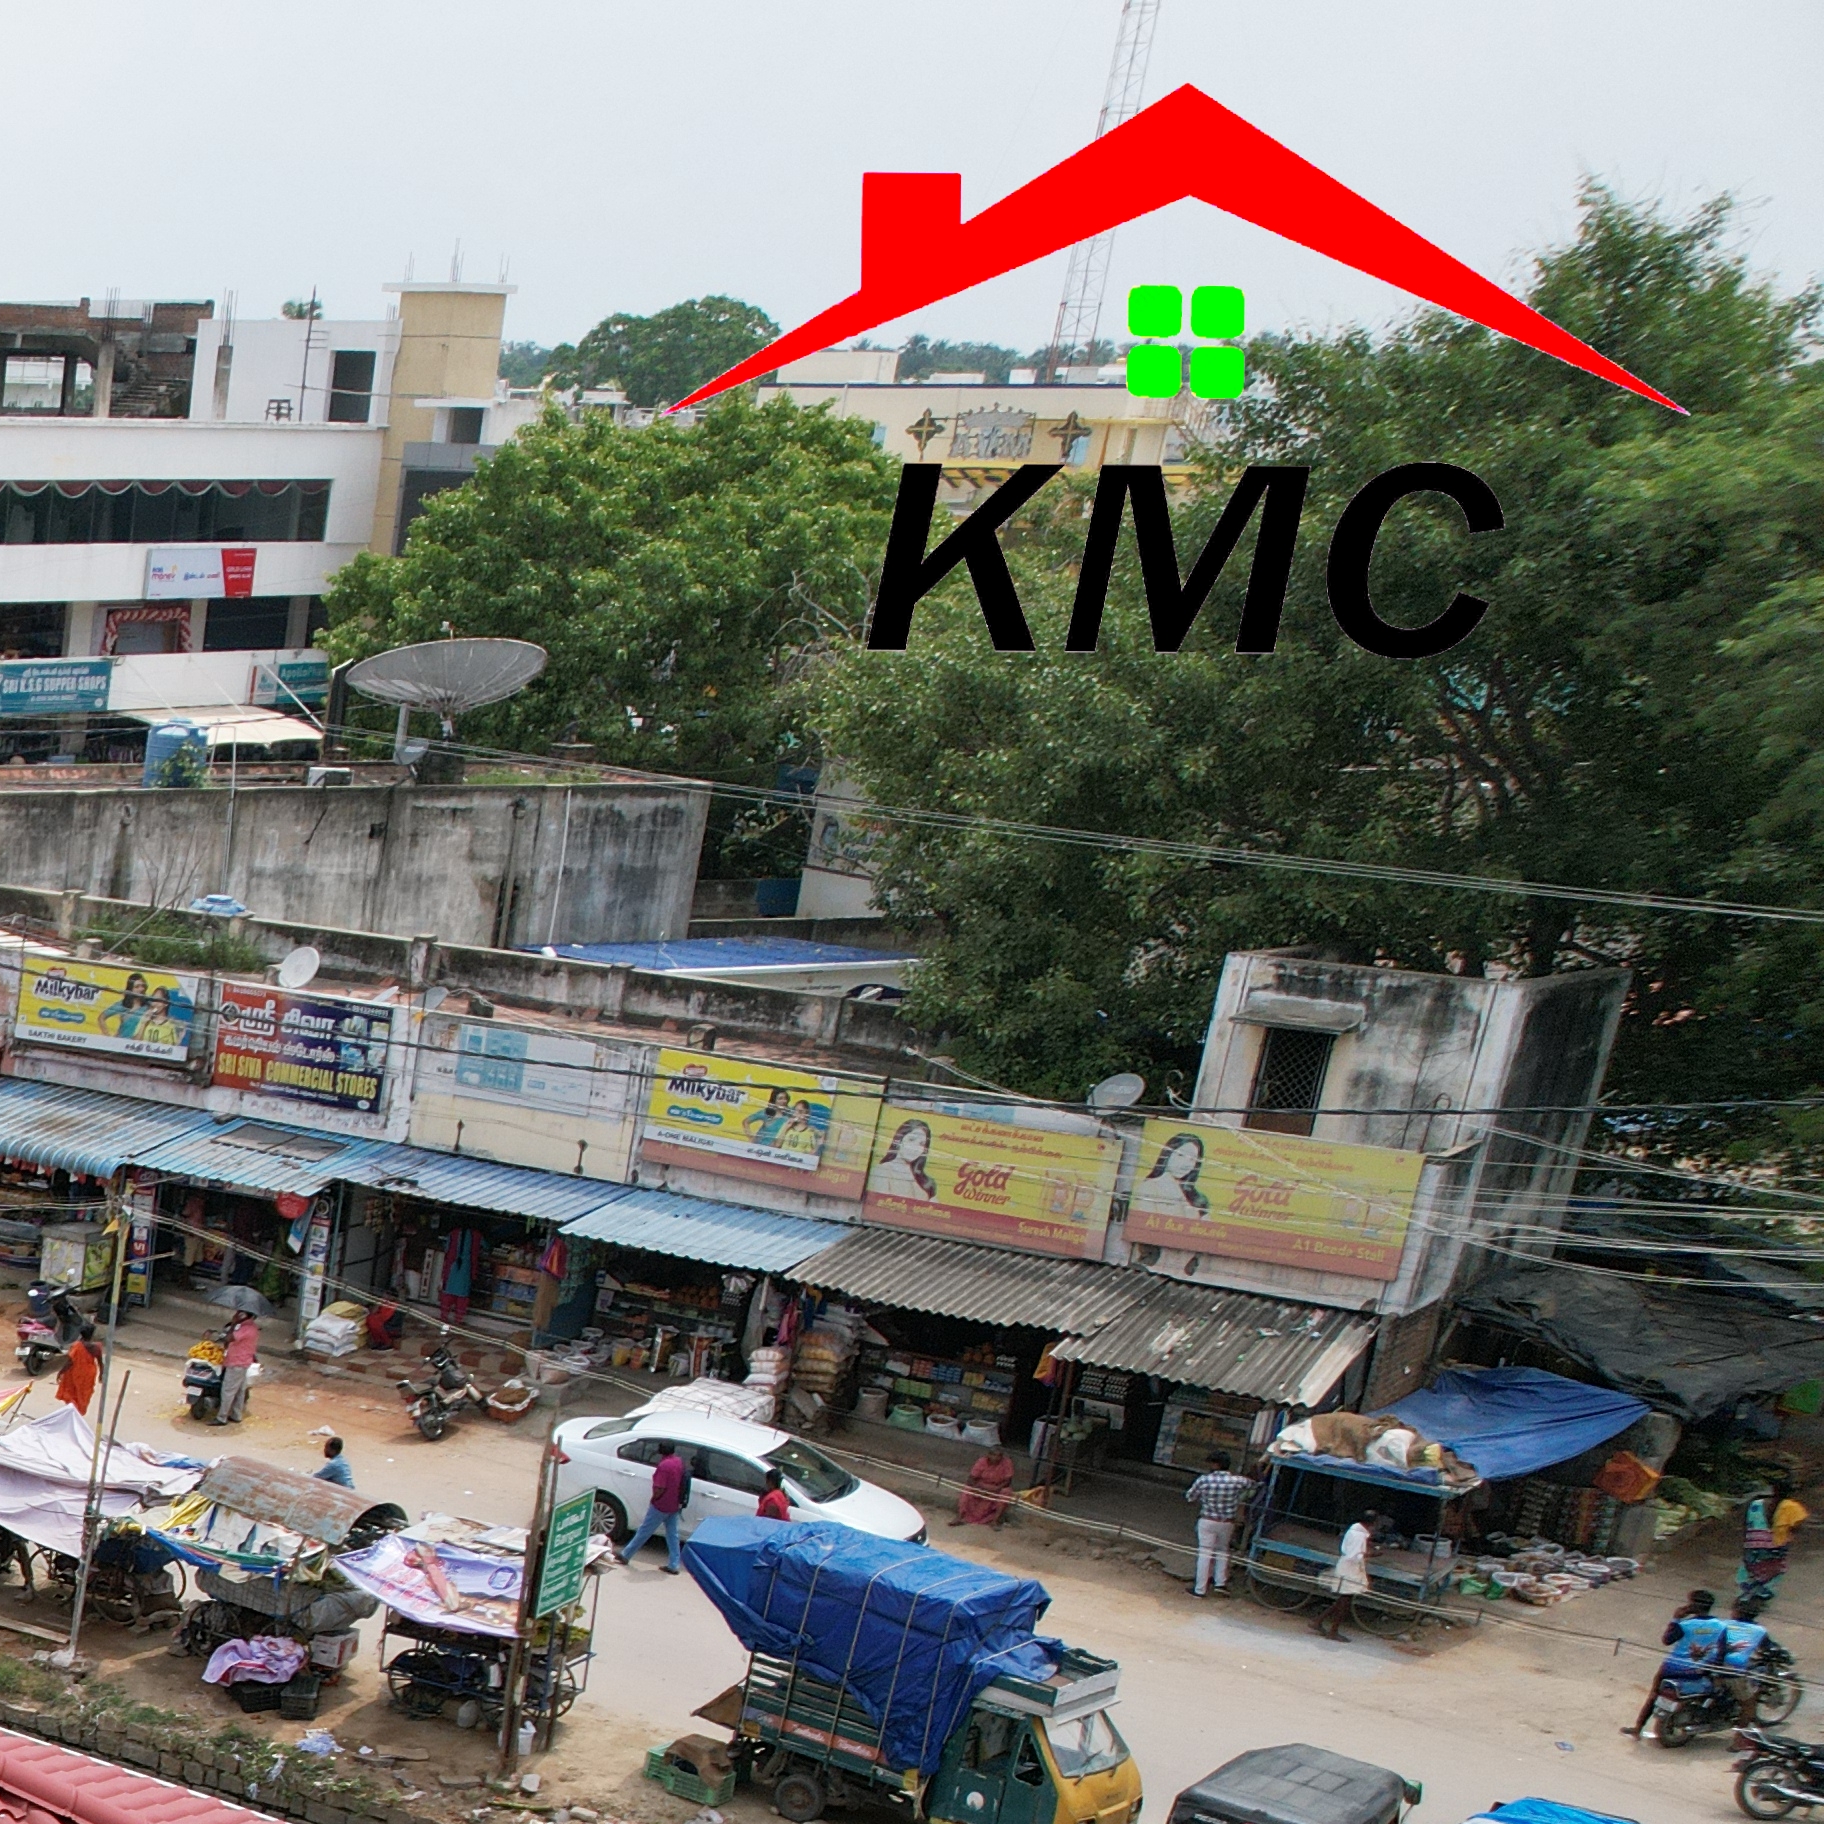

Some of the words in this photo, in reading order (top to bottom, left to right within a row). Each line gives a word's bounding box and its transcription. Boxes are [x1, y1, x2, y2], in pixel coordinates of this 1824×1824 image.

[34, 978, 101, 1002] Milkybar
[56, 1034, 88, 1044] BAKERY
[218, 1051, 237, 1075] SRI
[237, 1054, 262, 1080] SIVA
[265, 1059, 335, 1092] COMMERCIAL
[336, 1071, 377, 1100] STORES
[667, 1077, 746, 1105] Milkybar
[953, 1161, 1016, 1195] Gold
[554, 1526, 585, 1549] Bargur
